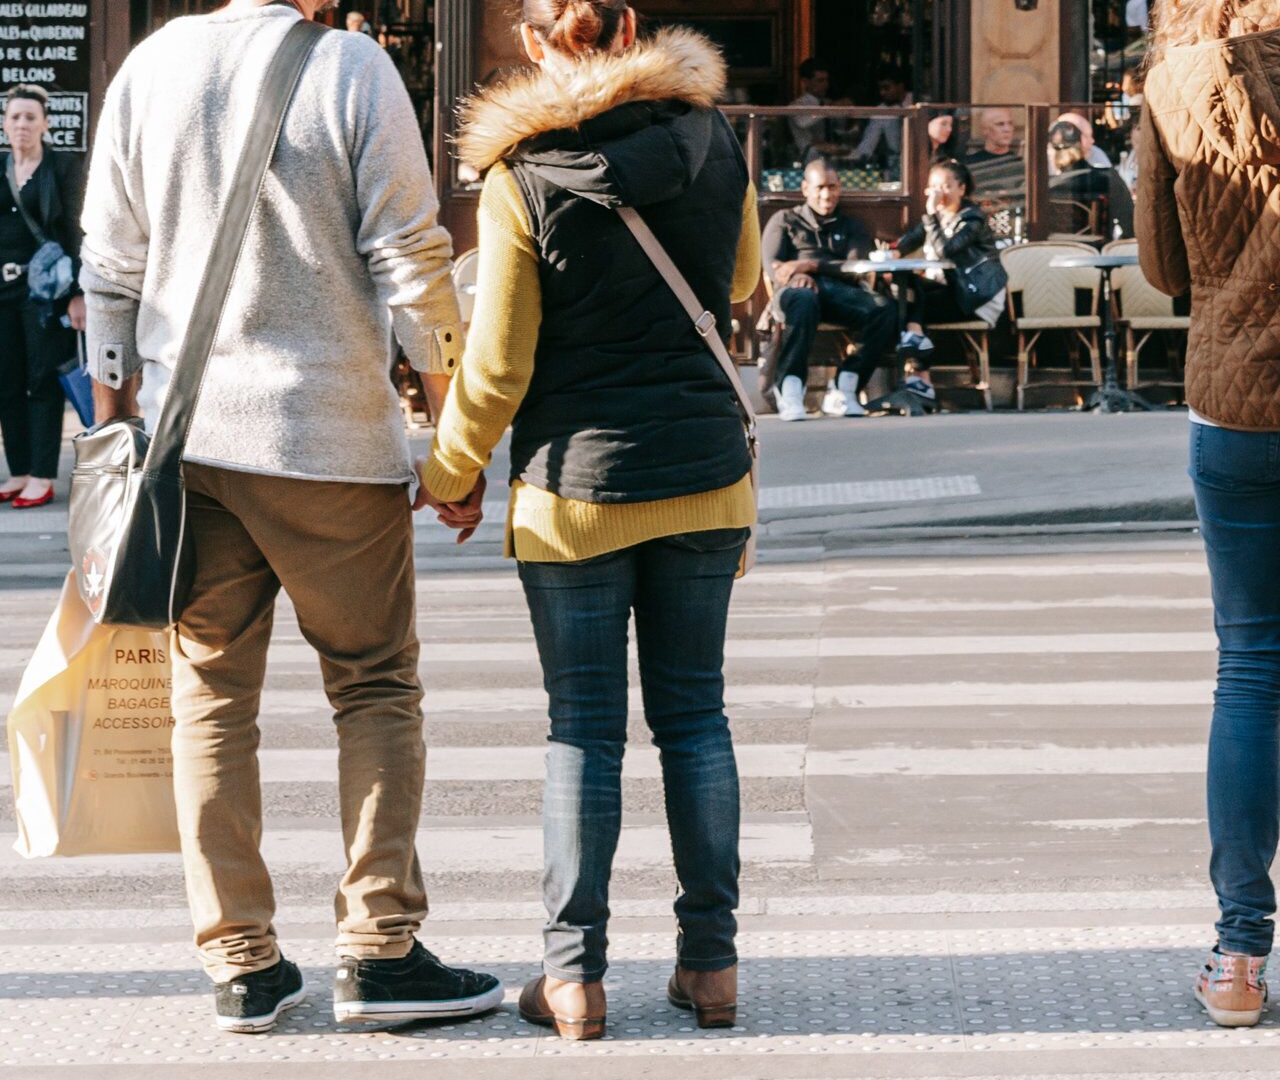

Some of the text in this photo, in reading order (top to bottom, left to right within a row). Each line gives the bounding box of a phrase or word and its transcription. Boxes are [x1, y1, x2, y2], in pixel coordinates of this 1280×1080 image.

[30, 25, 85, 41] QUIBERON
[7, 48, 22, 61] DE
[26, 47, 78, 61] CLAIRE
[2, 67, 56, 83] BELONS
[115, 649, 166, 664] PARIS
